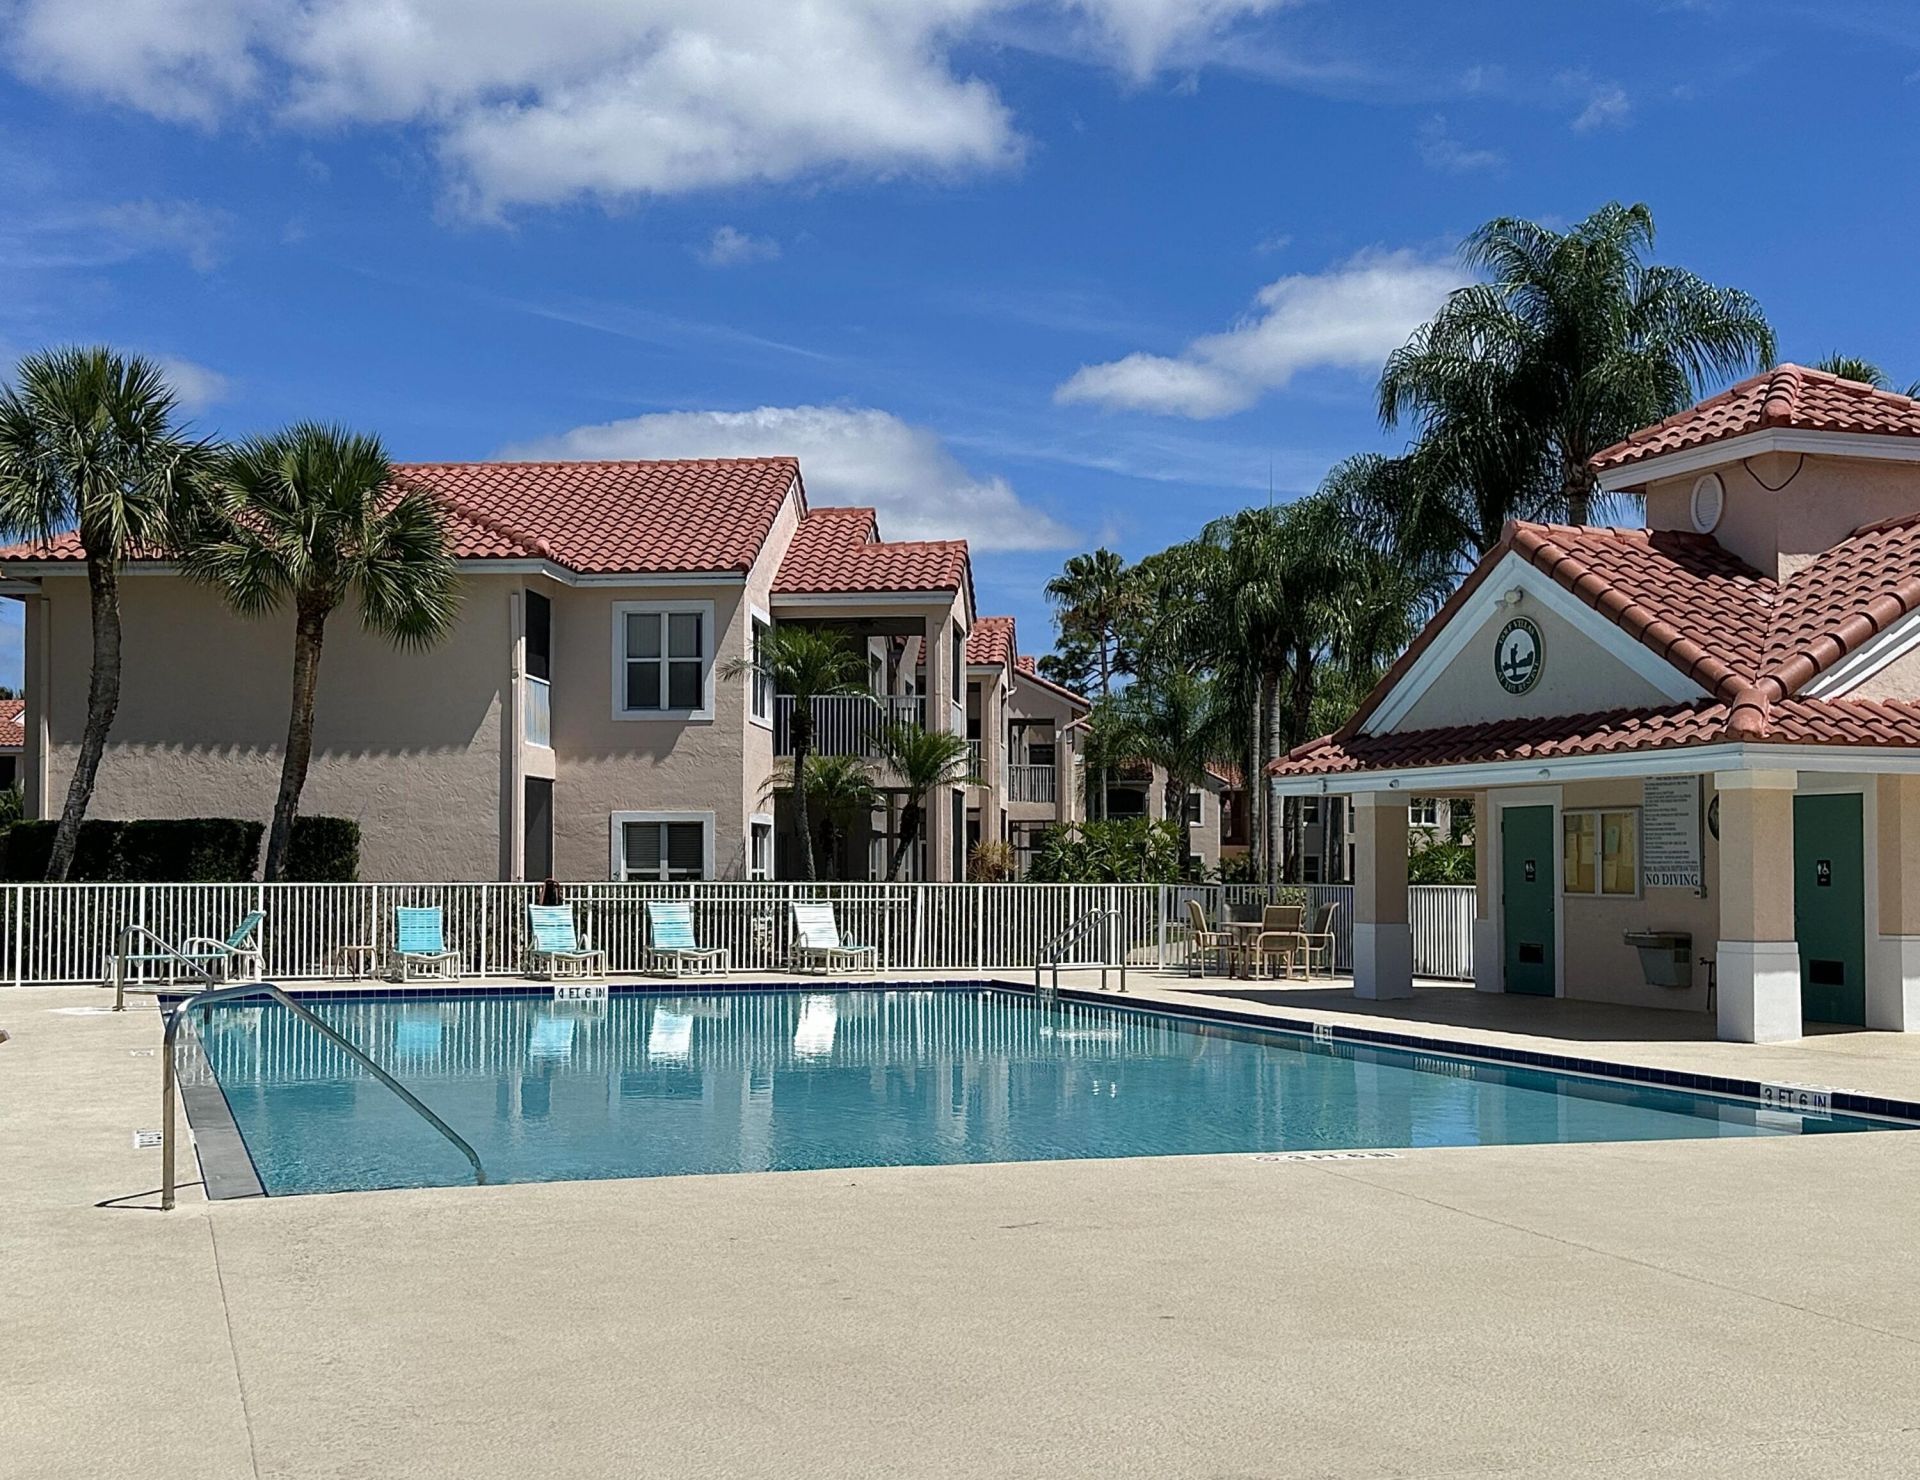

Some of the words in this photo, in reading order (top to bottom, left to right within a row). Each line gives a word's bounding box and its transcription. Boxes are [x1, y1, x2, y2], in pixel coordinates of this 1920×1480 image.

[1645, 873, 1660, 885] NO
[1662, 873, 1698, 886] DIVING
[1764, 1087, 1773, 1102] 3
[1778, 1088, 1794, 1103] FT
[1799, 1093, 1808, 1106] 6
[1814, 1094, 1826, 1108] IN
